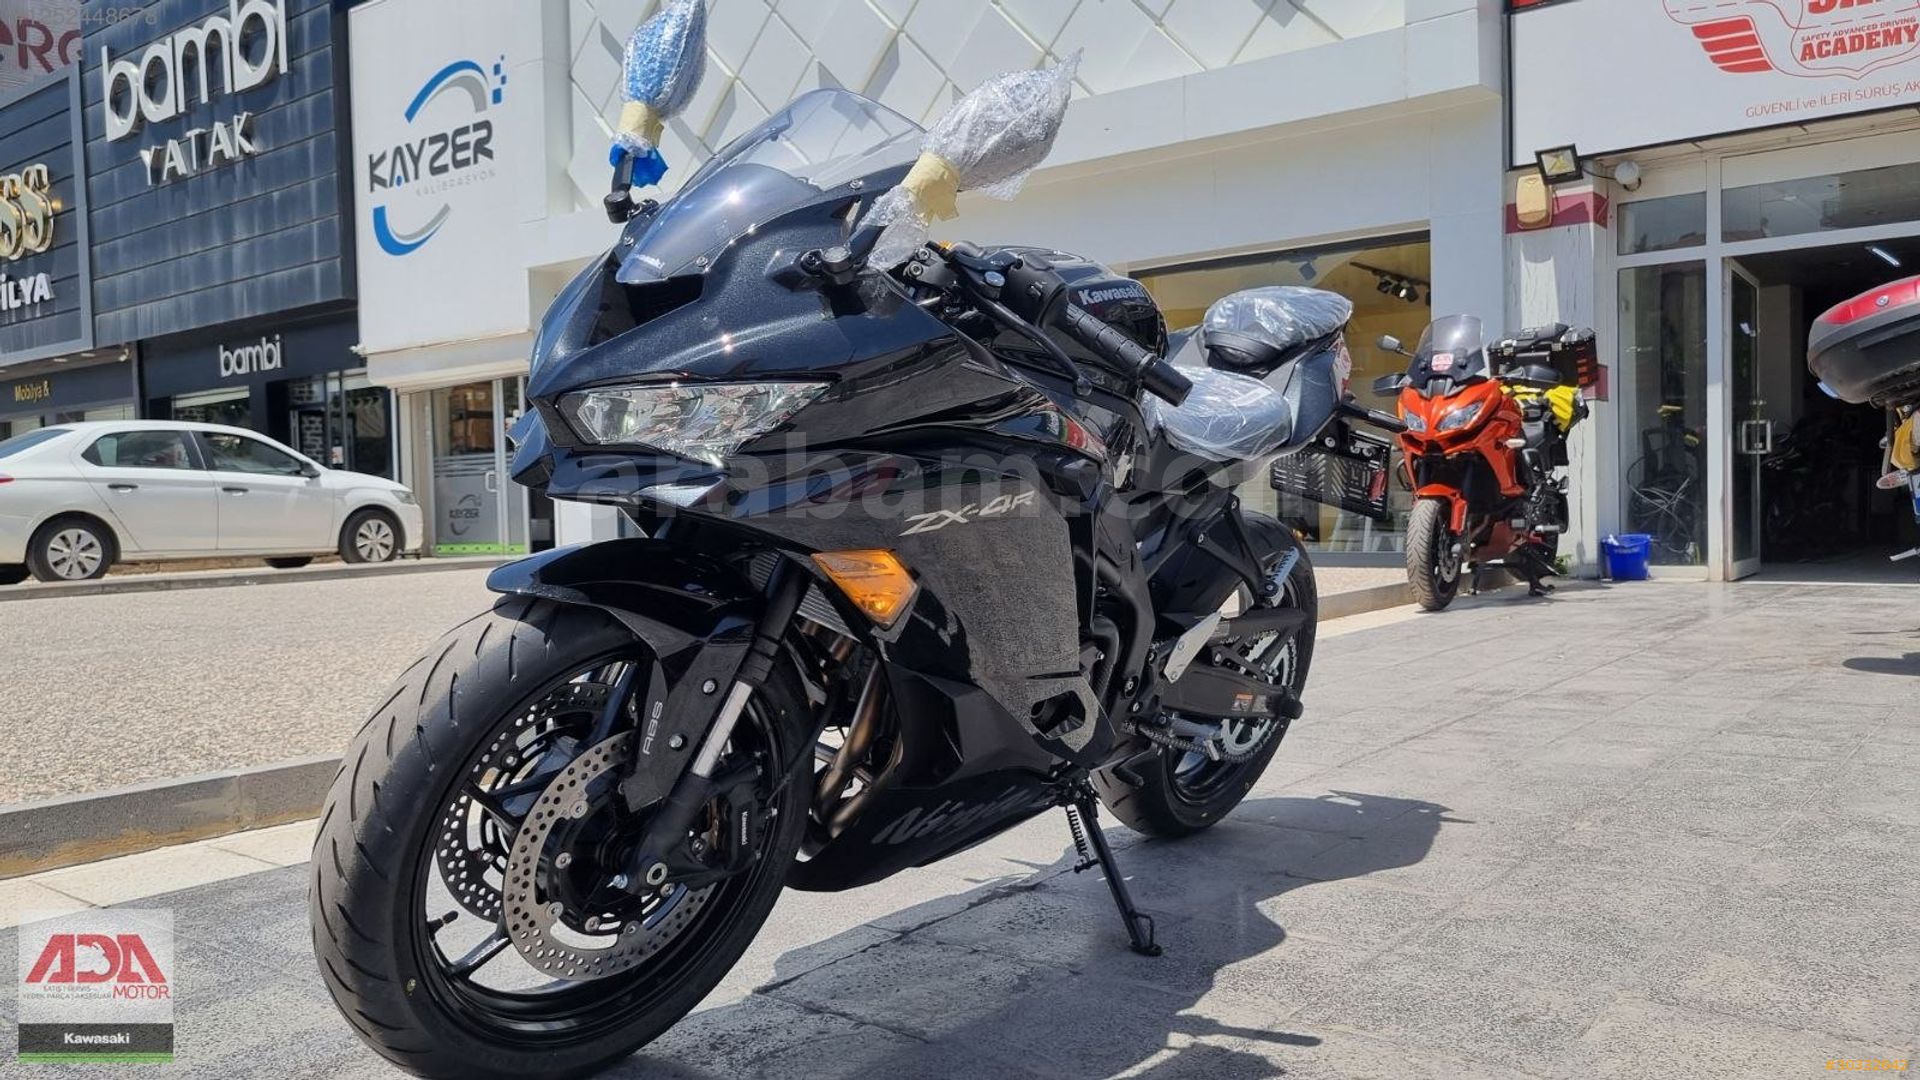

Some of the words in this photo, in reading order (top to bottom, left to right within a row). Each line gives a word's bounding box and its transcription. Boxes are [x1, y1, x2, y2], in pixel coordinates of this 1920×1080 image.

[1799, 23, 1920, 62] ACADEMY
[102, 0, 288, 142] bambi
[140, 112, 255, 186] YATAK
[369, 119, 494, 193] KAYZER
[1078, 284, 1147, 305] Kawasaki
[219, 333, 281, 378] bambi
[899, 490, 1034, 537] ZX-4R
[643, 701, 663, 756] ABS
